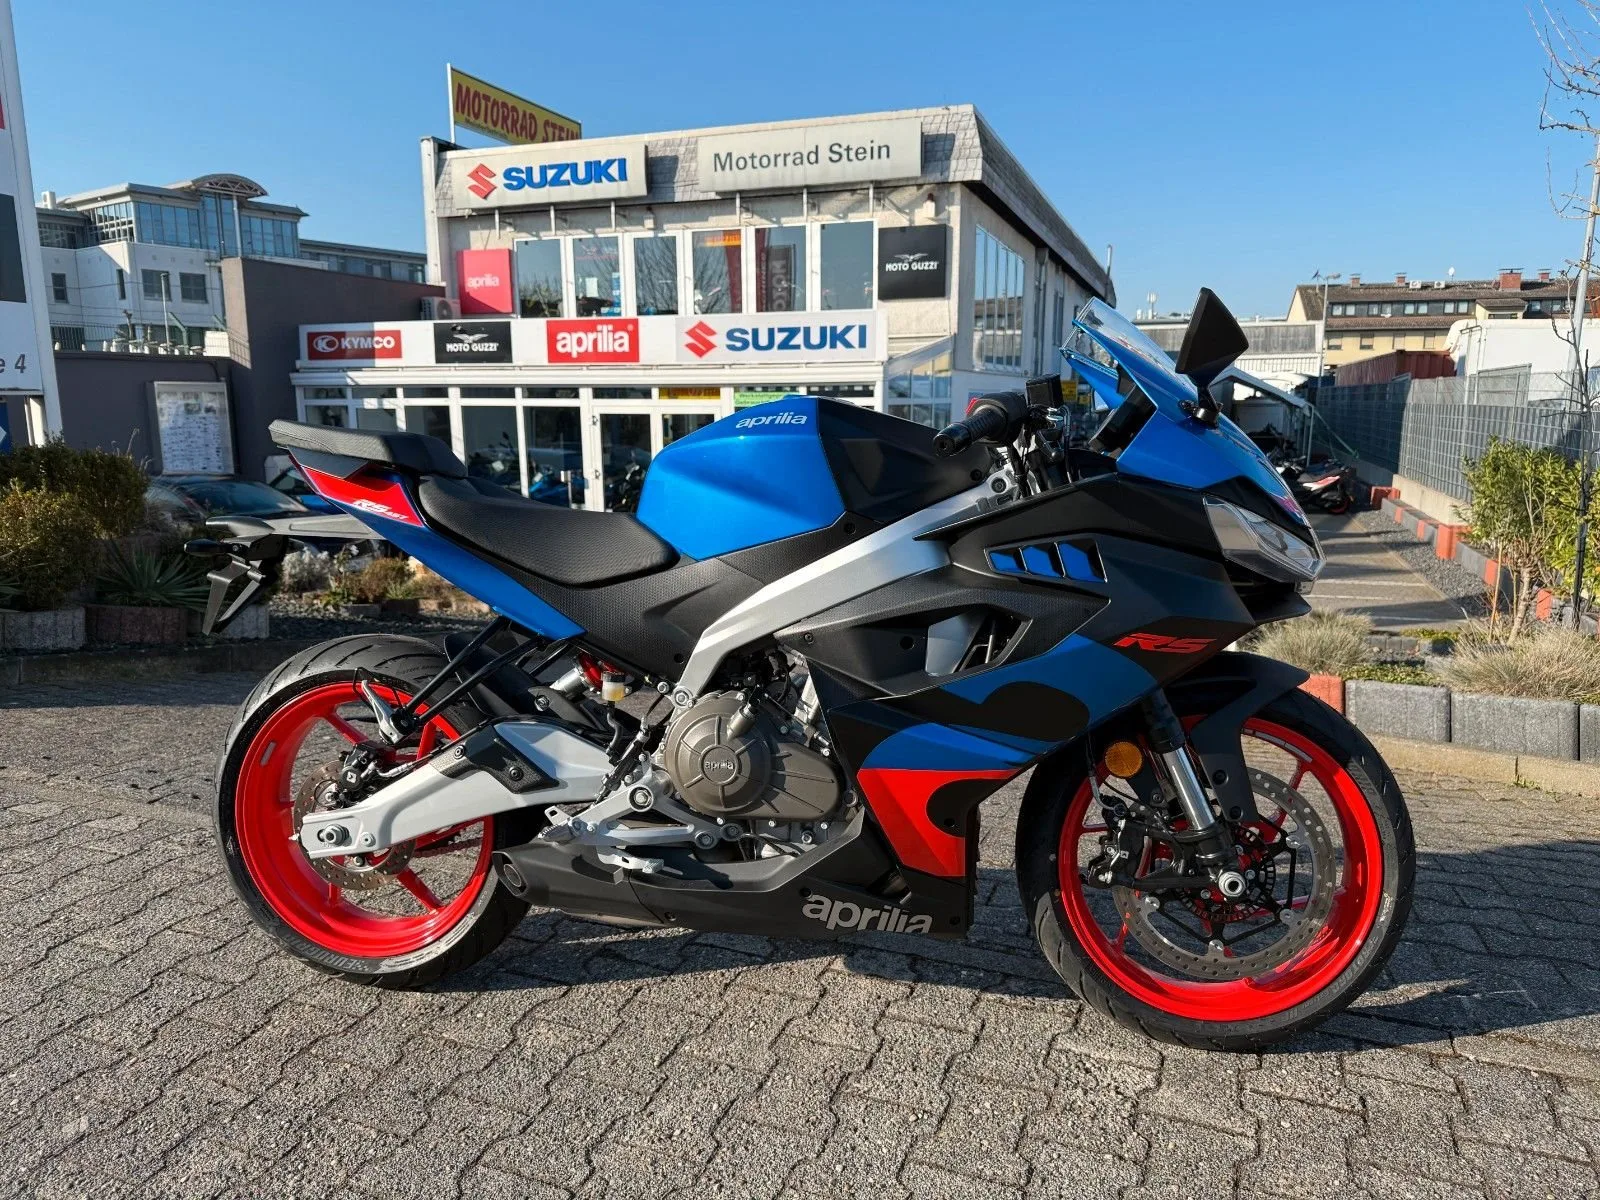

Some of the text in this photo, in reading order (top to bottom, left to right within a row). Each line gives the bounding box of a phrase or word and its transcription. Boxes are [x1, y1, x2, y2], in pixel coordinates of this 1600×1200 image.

[455, 82, 538, 142] MOTORRAD
[714, 140, 890, 173] Motorrad Stein
[503, 158, 627, 191] SUZUKI
[885, 260, 938, 271] MOTO GUZZI
[467, 273, 499, 289] aprilia
[341, 335, 395, 349] KYMCO
[446, 343, 498, 352] MOTO GUZZI
[556, 324, 629, 358] aprilia
[725, 324, 867, 351] SUZUKI
[15, 354, 26, 373] 4
[736, 412, 807, 429] aprilia
[1113, 633, 1217, 654] RS
[704, 761, 734, 772] aprilia
[802, 894, 933, 934] aprilia
